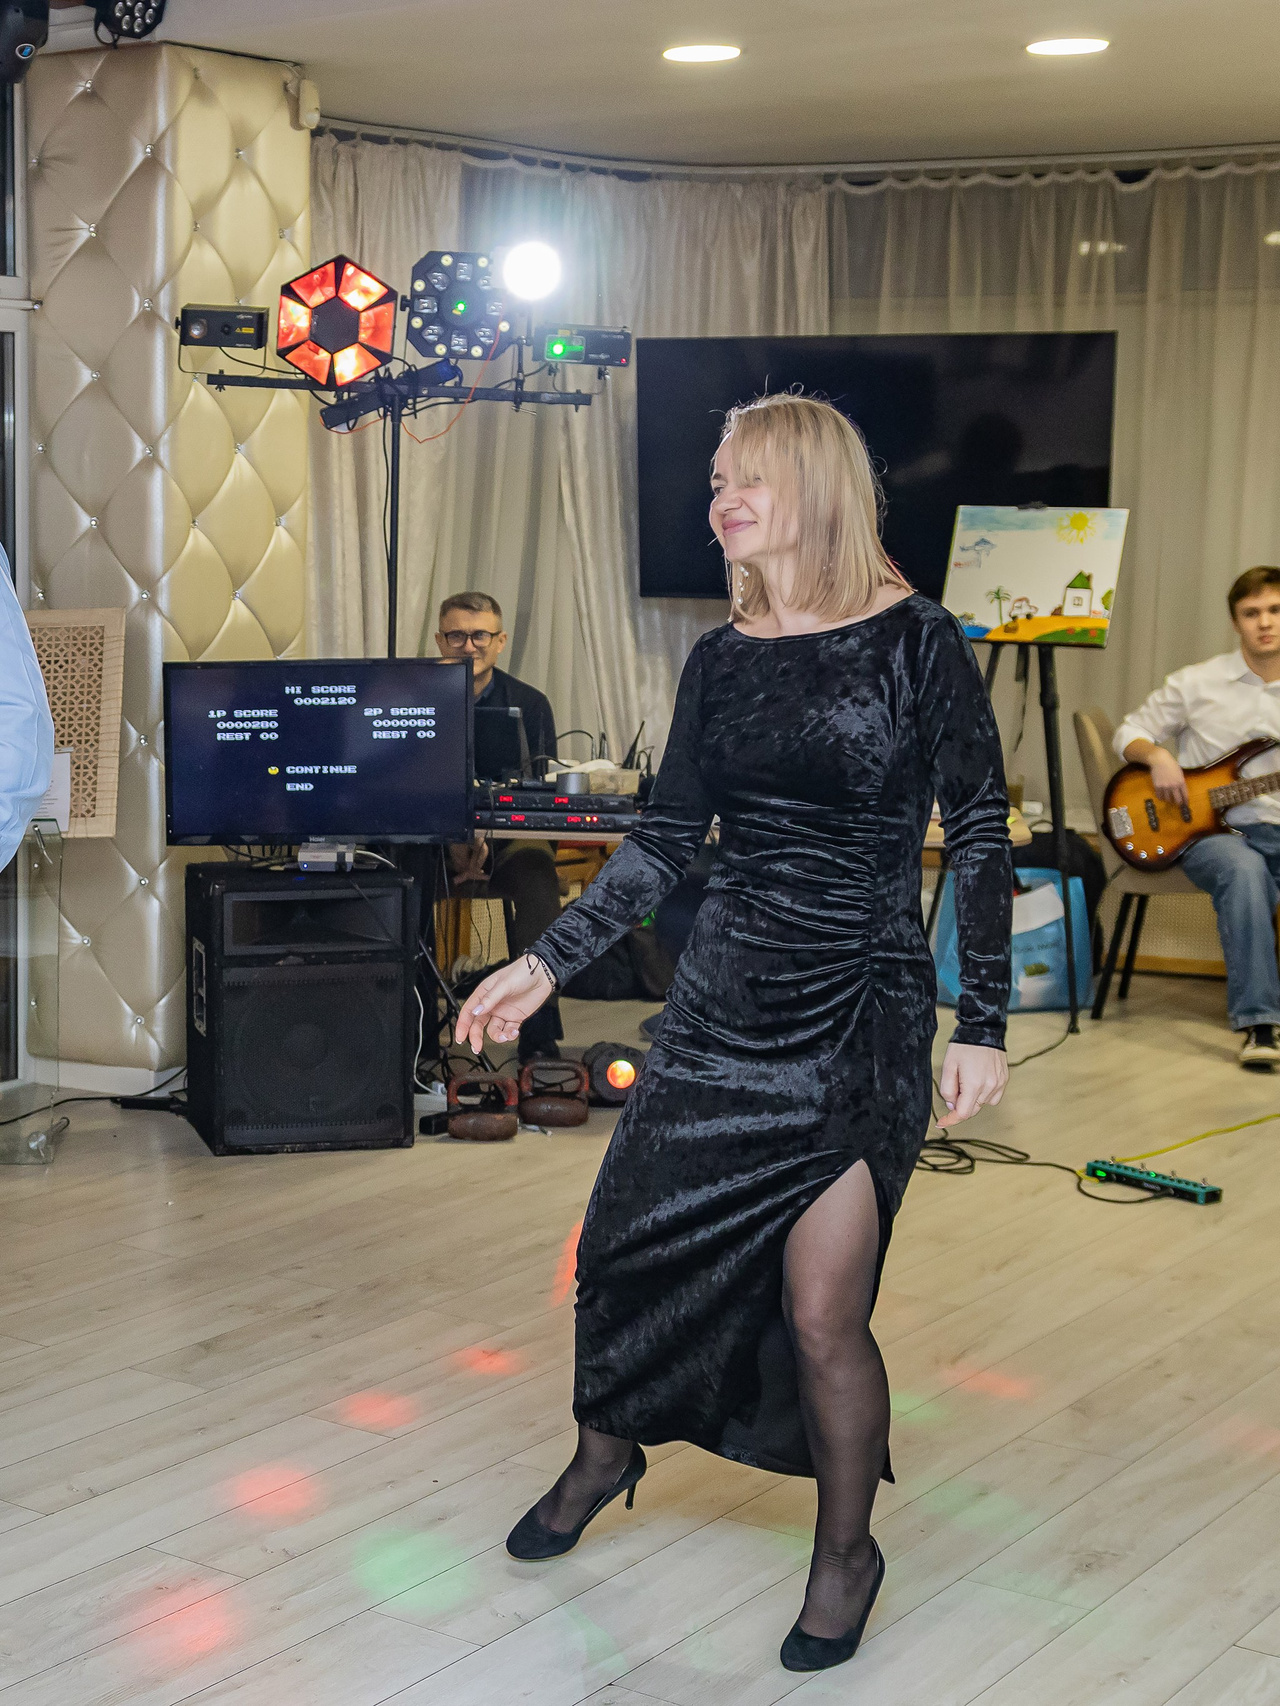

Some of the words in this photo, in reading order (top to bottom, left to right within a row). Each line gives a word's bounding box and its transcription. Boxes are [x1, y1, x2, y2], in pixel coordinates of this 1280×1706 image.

[284, 686, 302, 695] HI
[311, 685, 357, 694] SCORE
[293, 697, 357, 706] 0002120
[207, 709, 227, 718] 1P
[233, 709, 279, 718] SCORE
[363, 707, 383, 717] 2P
[390, 706, 436, 716] SCORE
[216, 732, 252, 741] REST
[259, 731, 279, 740] 00
[372, 730, 409, 739] REST
[416, 730, 436, 739] 00
[285, 765, 358, 775] CONTINUE
[285, 782, 315, 791] END
